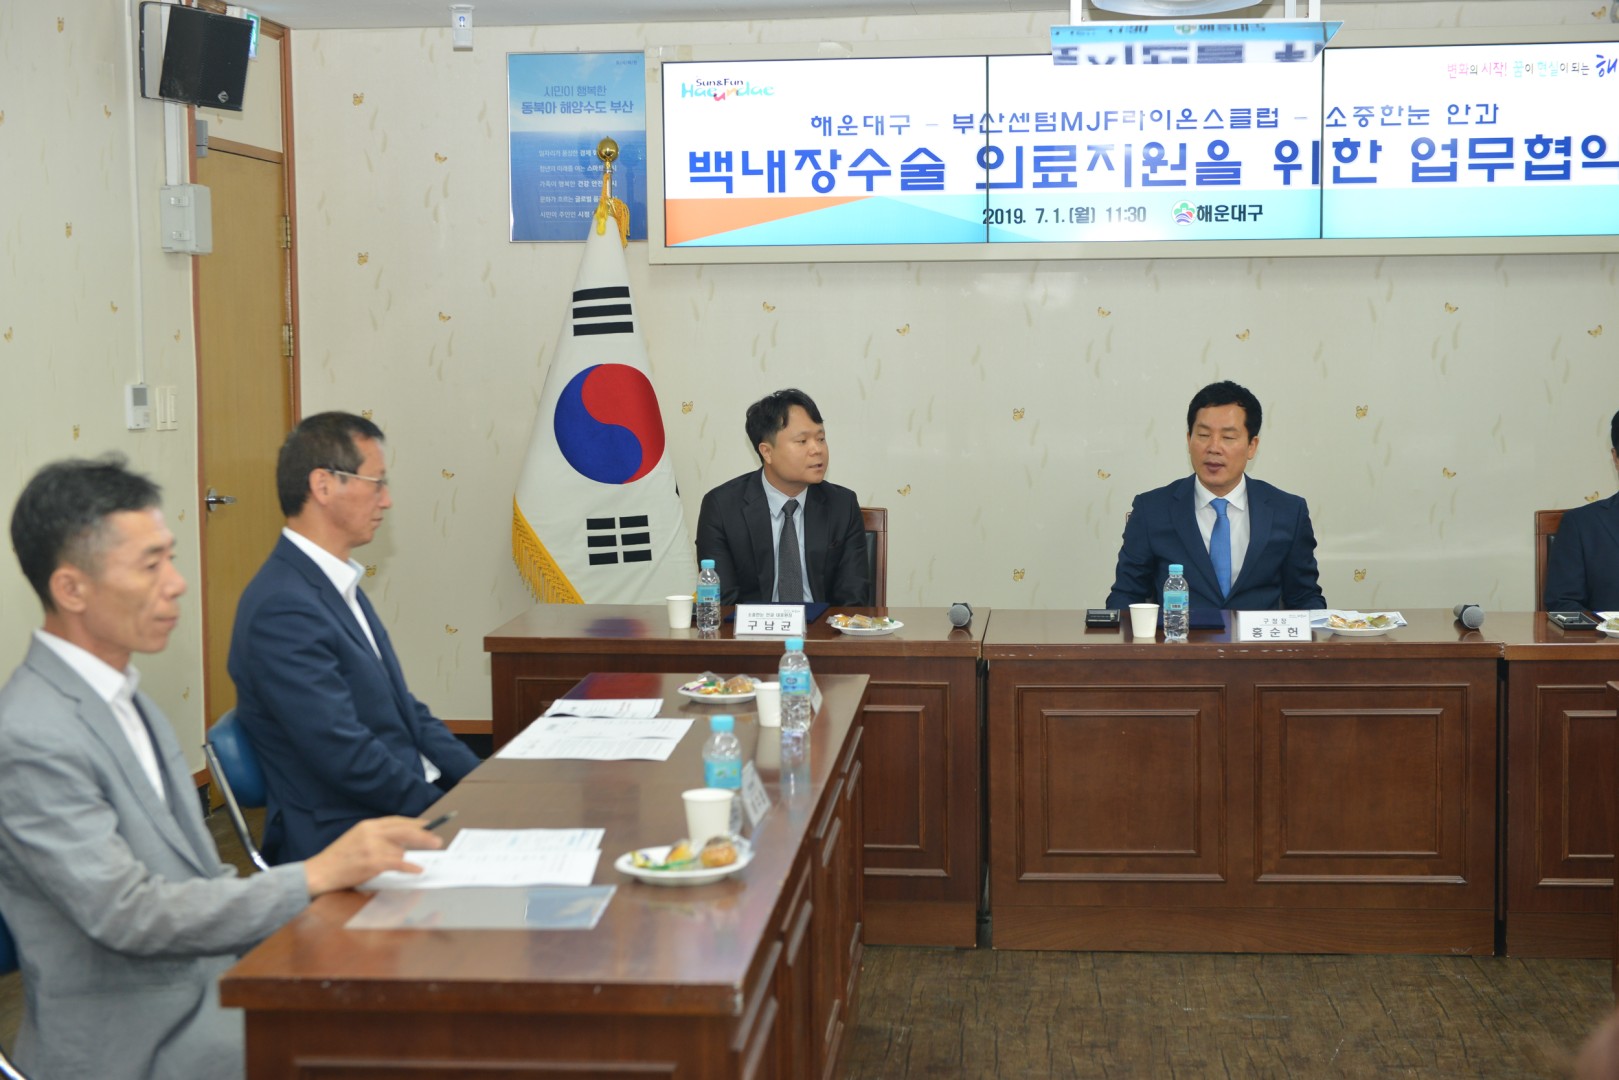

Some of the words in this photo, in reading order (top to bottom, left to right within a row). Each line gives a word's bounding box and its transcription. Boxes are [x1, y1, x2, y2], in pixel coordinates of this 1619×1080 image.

[1448, 63, 1478, 79] 변화의
[1482, 62, 1507, 77] 시작!
[1512, 60, 1534, 78] 꿈이
[1537, 61, 1569, 77] 현실이
[1571, 62, 1590, 76] 되는
[544, 85, 574, 97] 시민이
[577, 85, 607, 97] 행복한
[681, 81, 775, 101] Haeundae
[696, 78, 744, 87] Sun&Fun
[521, 101, 557, 115] 동북아
[560, 101, 607, 114] 해양수도
[610, 100, 634, 114] 부산
[811, 114, 911, 137] 해운대구
[952, 108, 1279, 134] 부산센텀MJF라이온스클럽
[1325, 104, 1431, 128] 소중한눈
[1447, 103, 1500, 125] 안과
[688, 147, 946, 194] 백내장수술
[975, 139, 1243, 191] 의료지원을
[1273, 137, 1383, 186] 위한
[558, 180, 576, 188] 행복한
[577, 180, 590, 188] 건강
[575, 195, 592, 203] 글로벌
[982, 208, 1027, 225] 2019.
[1105, 205, 1147, 223] 11:30
[1196, 204, 1264, 222] 해운대구
